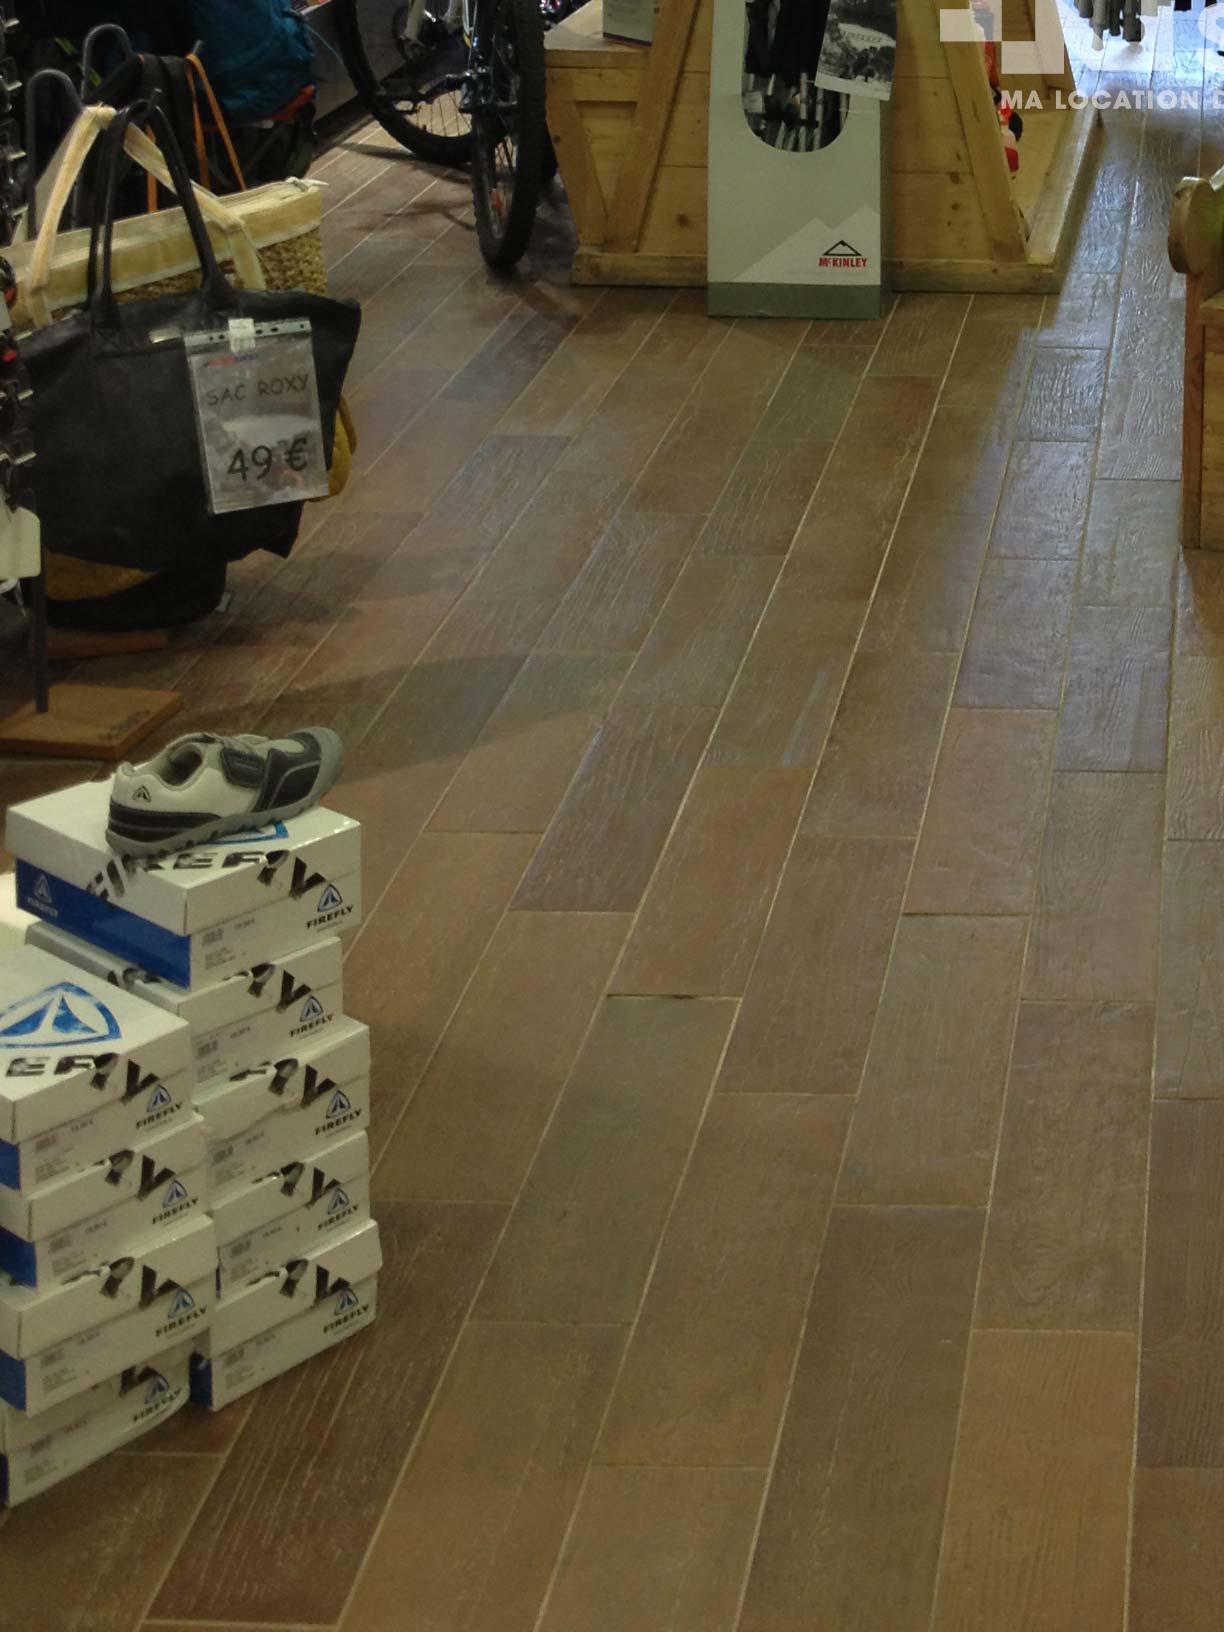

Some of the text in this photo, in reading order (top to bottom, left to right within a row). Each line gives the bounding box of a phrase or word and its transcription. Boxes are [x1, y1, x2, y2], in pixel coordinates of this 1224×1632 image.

[206, 374, 309, 406] SAC ROXY
[306, 904, 354, 930] FIREFLY
[289, 1013, 334, 1037] FIREFLY
[136, 1101, 183, 1129] FIREFLY
[314, 1108, 362, 1135] FIREFLY
[151, 1198, 199, 1225] FIREFLY
[317, 1204, 360, 1231] FIREFLY
[155, 1307, 207, 1337] FIREFLY
[322, 1303, 370, 1334] FIREFLY
